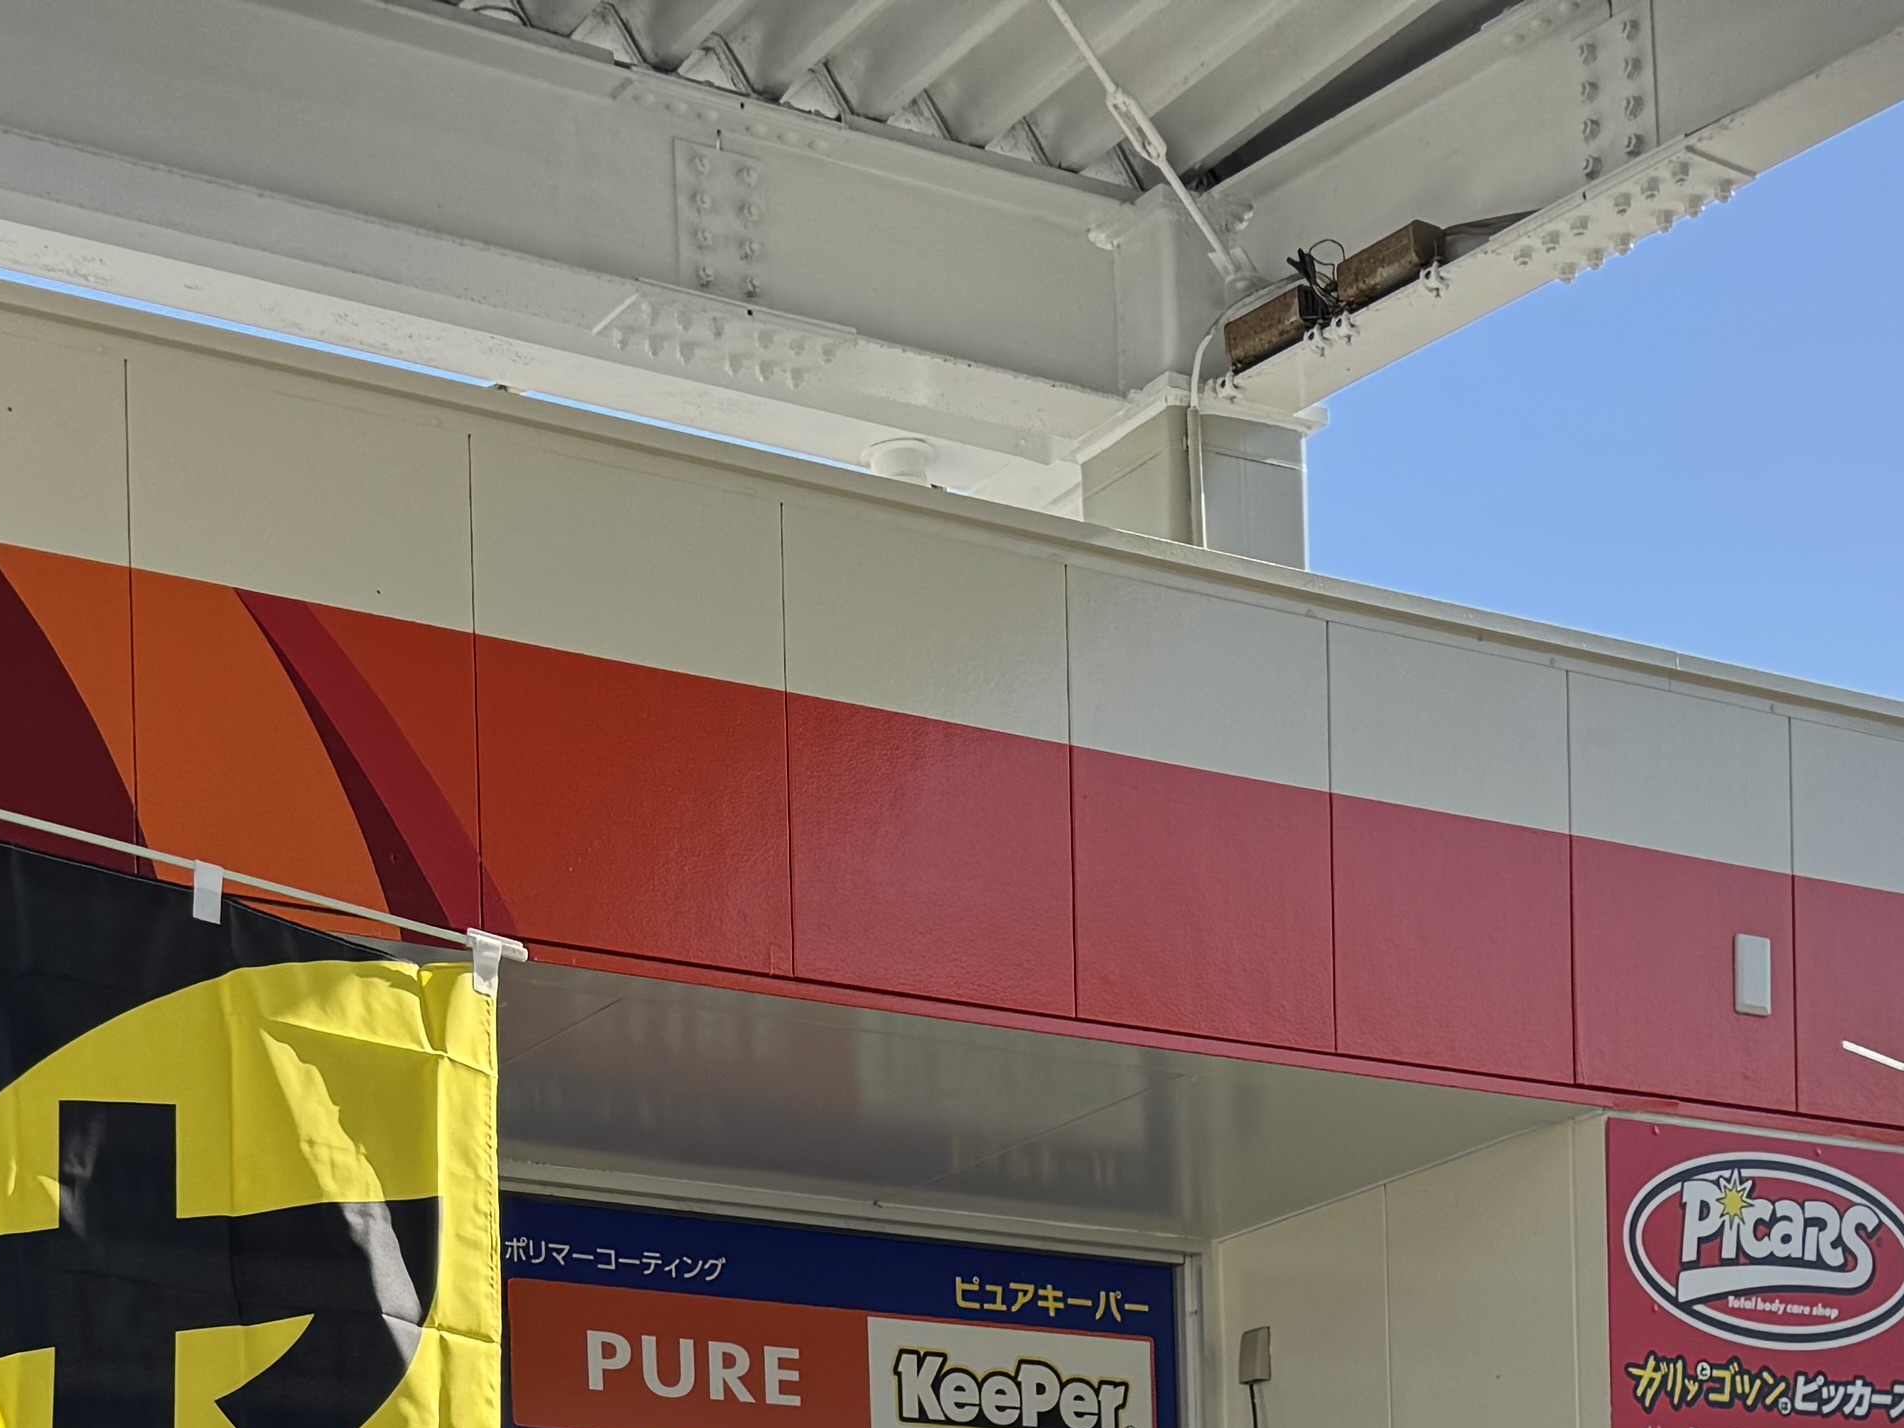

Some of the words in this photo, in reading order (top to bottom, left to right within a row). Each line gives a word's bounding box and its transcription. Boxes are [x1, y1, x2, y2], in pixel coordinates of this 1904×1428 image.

[504, 1237, 726, 1281] ポリマーコーティング
[954, 1276, 1150, 1322] ピュアキーパー
[1727, 1295, 1755, 1312] Total
[1757, 1297, 1784, 1317] body
[1786, 1304, 1810, 1317] care
[1812, 1303, 1839, 1320] shop
[586, 1328, 802, 1407] PURE
